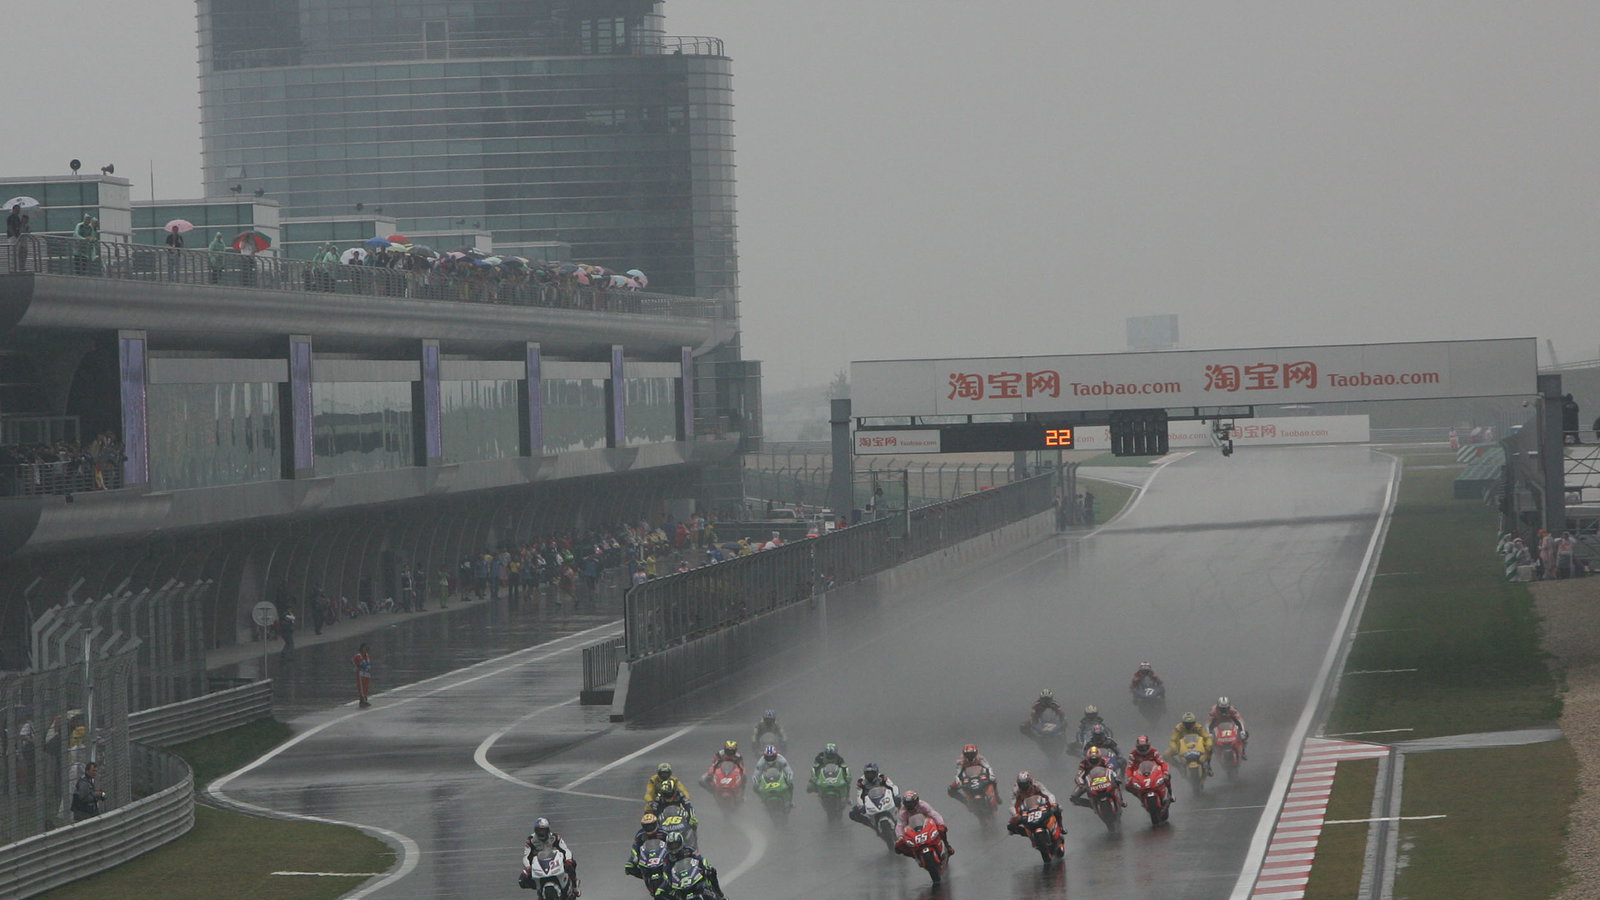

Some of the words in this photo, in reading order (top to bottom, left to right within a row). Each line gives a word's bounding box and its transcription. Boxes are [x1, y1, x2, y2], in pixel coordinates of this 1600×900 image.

[1204, 361, 1318, 392] 淘宝网
[1328, 371, 1440, 387] Taobao.com
[948, 370, 1061, 400] 淘宝网
[1070, 381, 1182, 397] Taobao.com
[1045, 429, 1071, 446] 22
[1168, 431, 1207, 441] obao.com
[1280, 429, 1329, 438] Taobao.com
[859, 436, 897, 448] 淘宝网
[970, 778, 979, 787] 3
[1143, 778, 1151, 787] 7
[1027, 810, 1043, 822] 69
[915, 832, 928, 844] 65
